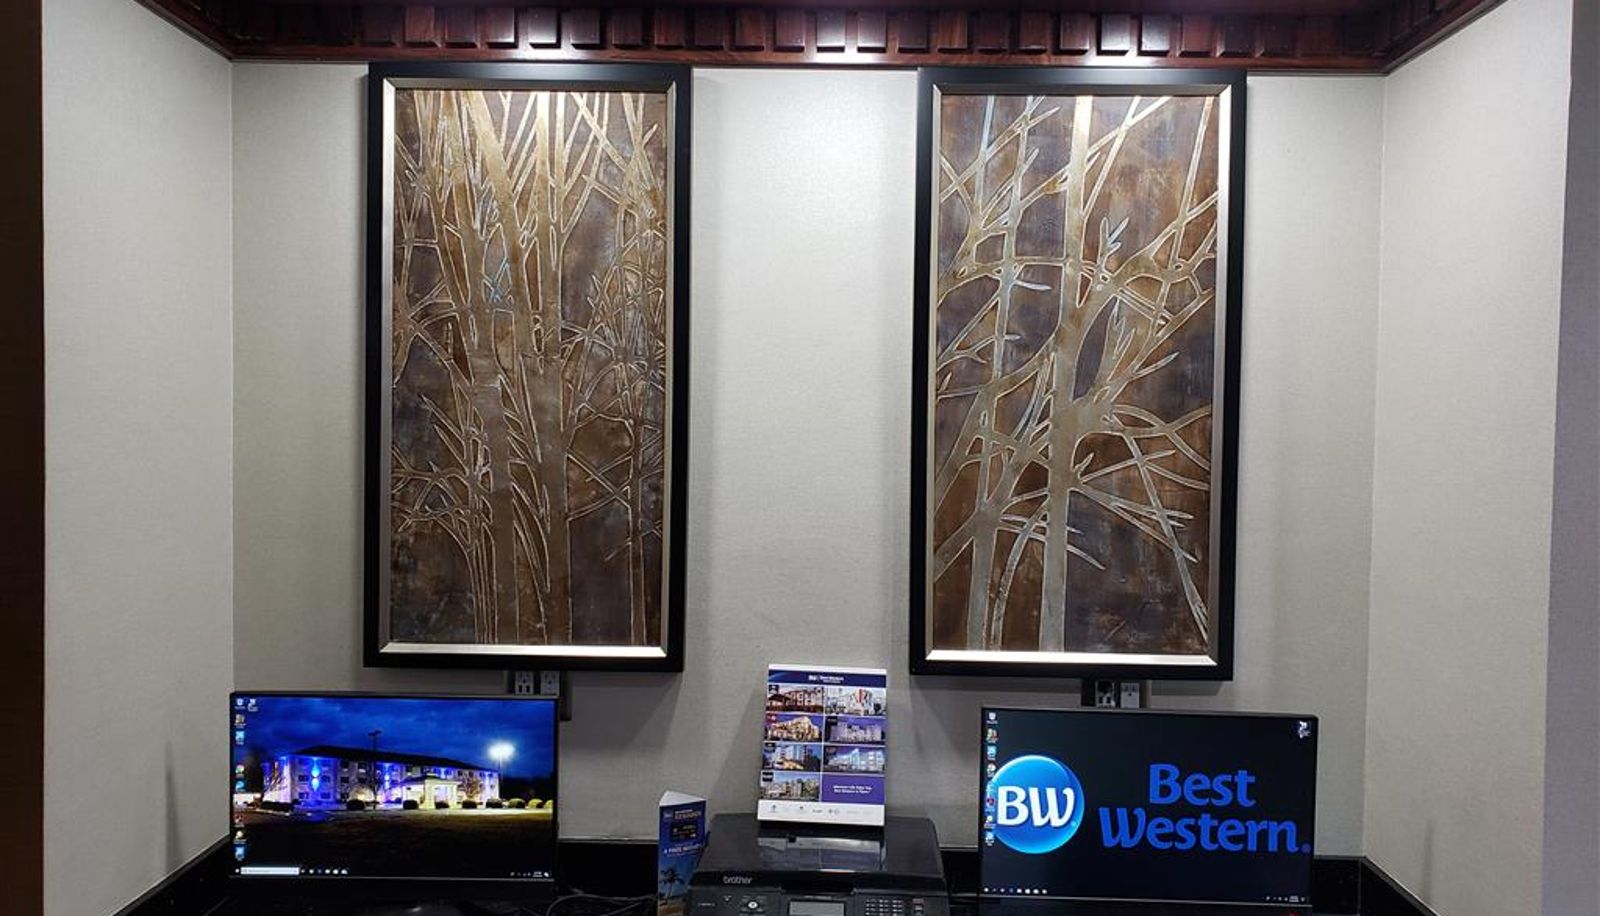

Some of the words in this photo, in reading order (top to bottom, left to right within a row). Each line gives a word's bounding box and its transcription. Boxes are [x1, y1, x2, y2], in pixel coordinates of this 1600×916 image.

[997, 785, 1075, 828] BW
[1149, 763, 1256, 807] Best
[723, 875, 752, 884] brother
